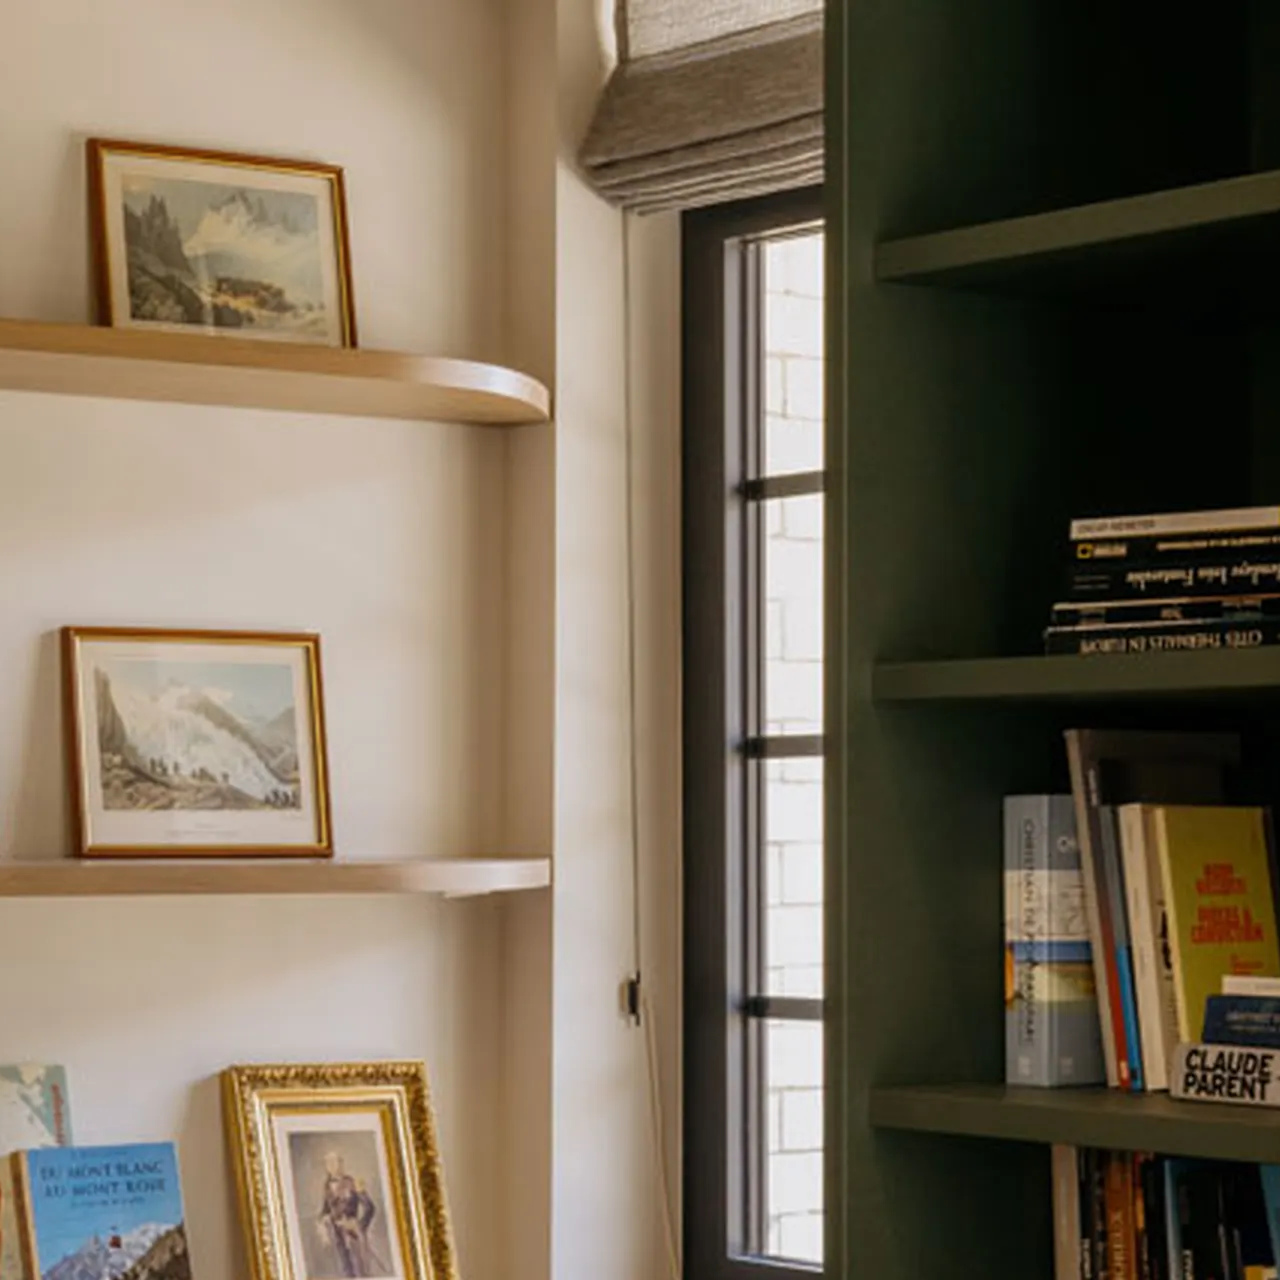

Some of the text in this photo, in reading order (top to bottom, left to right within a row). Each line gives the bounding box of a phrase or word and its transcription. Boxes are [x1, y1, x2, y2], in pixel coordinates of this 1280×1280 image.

[1022, 818, 1038, 903] CHRISTIAN
[1185, 1049, 1274, 1077] CLAUDE
[1182, 1072, 1272, 1101] PARENT
[67, 1162, 113, 1179] MONT
[115, 1159, 165, 1178] BLANC
[71, 1180, 120, 1197] MONT
